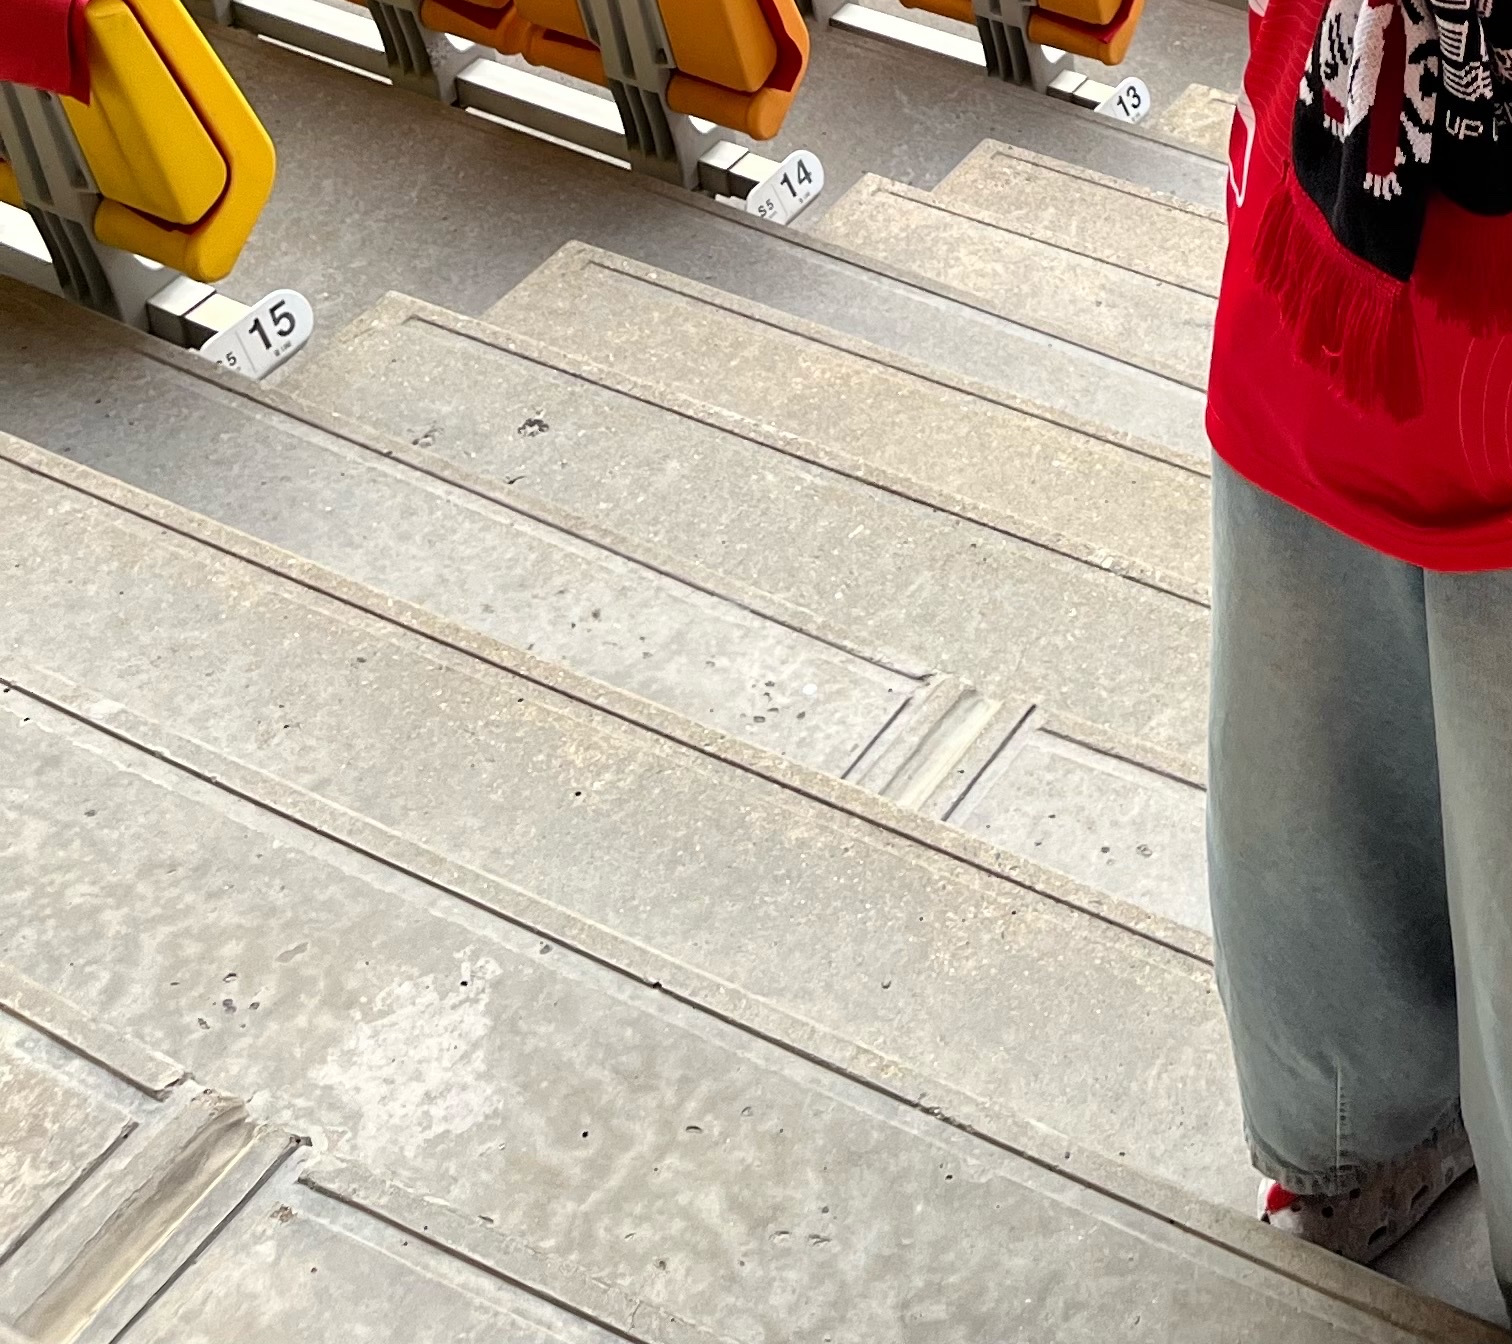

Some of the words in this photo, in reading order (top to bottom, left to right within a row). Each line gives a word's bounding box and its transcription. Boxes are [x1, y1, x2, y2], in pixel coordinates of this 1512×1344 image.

[1117, 86, 1141, 116] 13
[780, 159, 812, 197] 14
[248, 299, 297, 350] 15
